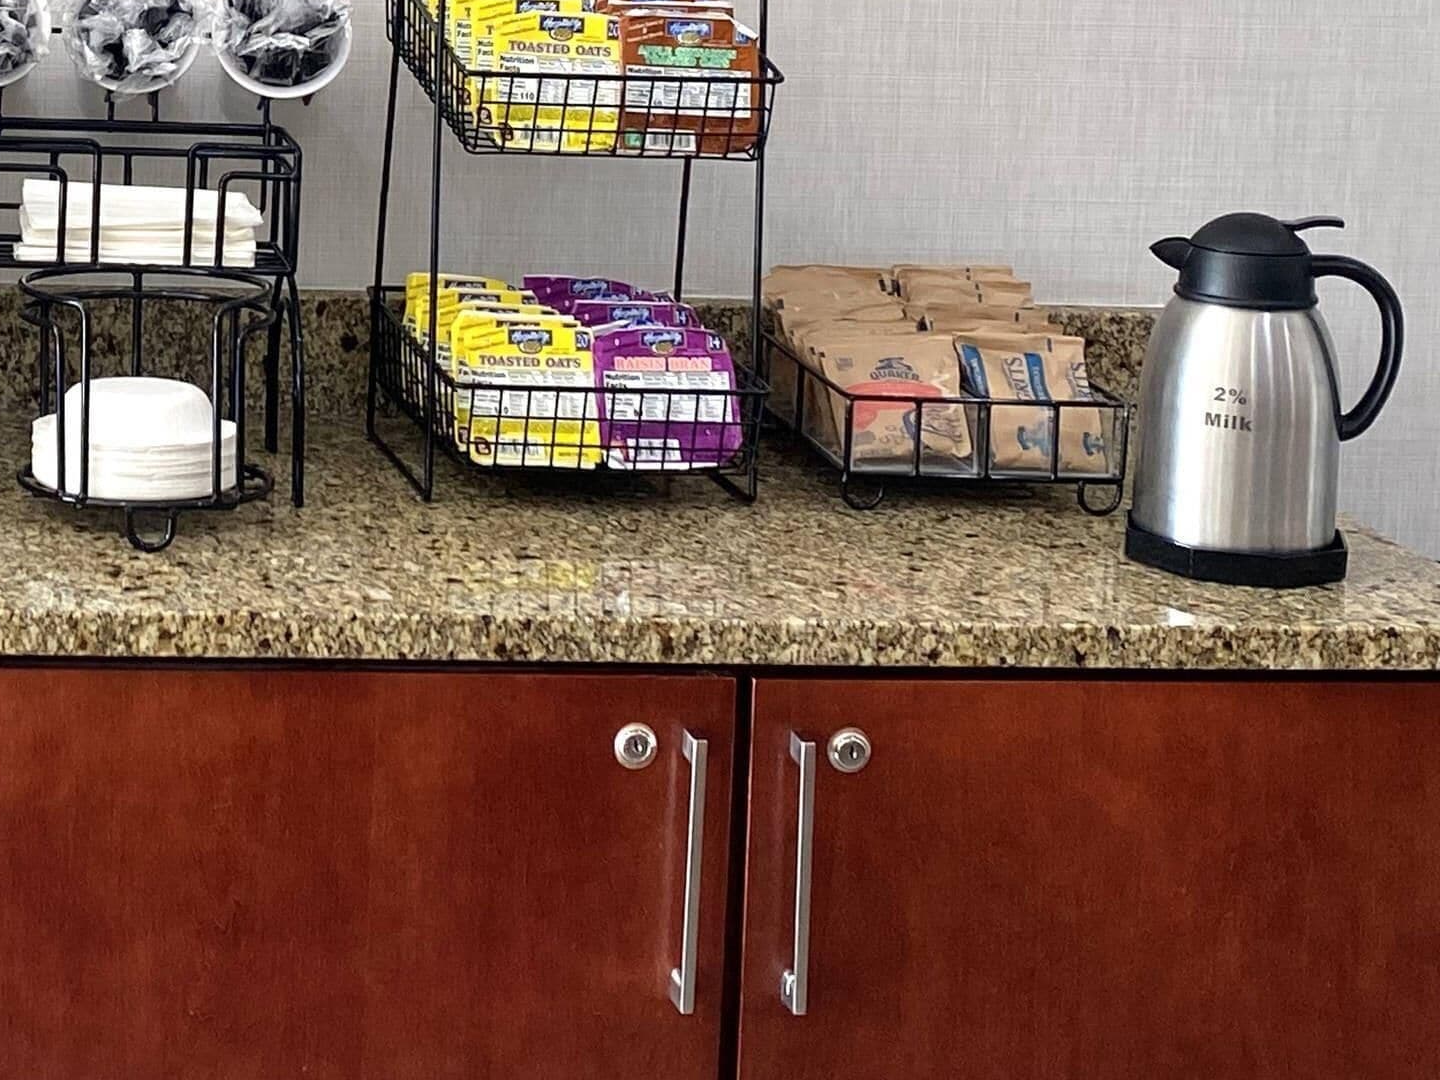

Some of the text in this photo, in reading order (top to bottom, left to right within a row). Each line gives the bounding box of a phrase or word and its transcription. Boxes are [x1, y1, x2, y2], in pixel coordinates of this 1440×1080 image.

[509, 39, 570, 54] TOASTED
[576, 45, 611, 57] OATS
[479, 354, 581, 369] TOASTED OATS
[615, 357, 711, 371] RAISIN BRAN
[870, 370, 920, 381] QUAKER
[1214, 387, 1247, 405] 2%
[1205, 412, 1252, 432] Milk
